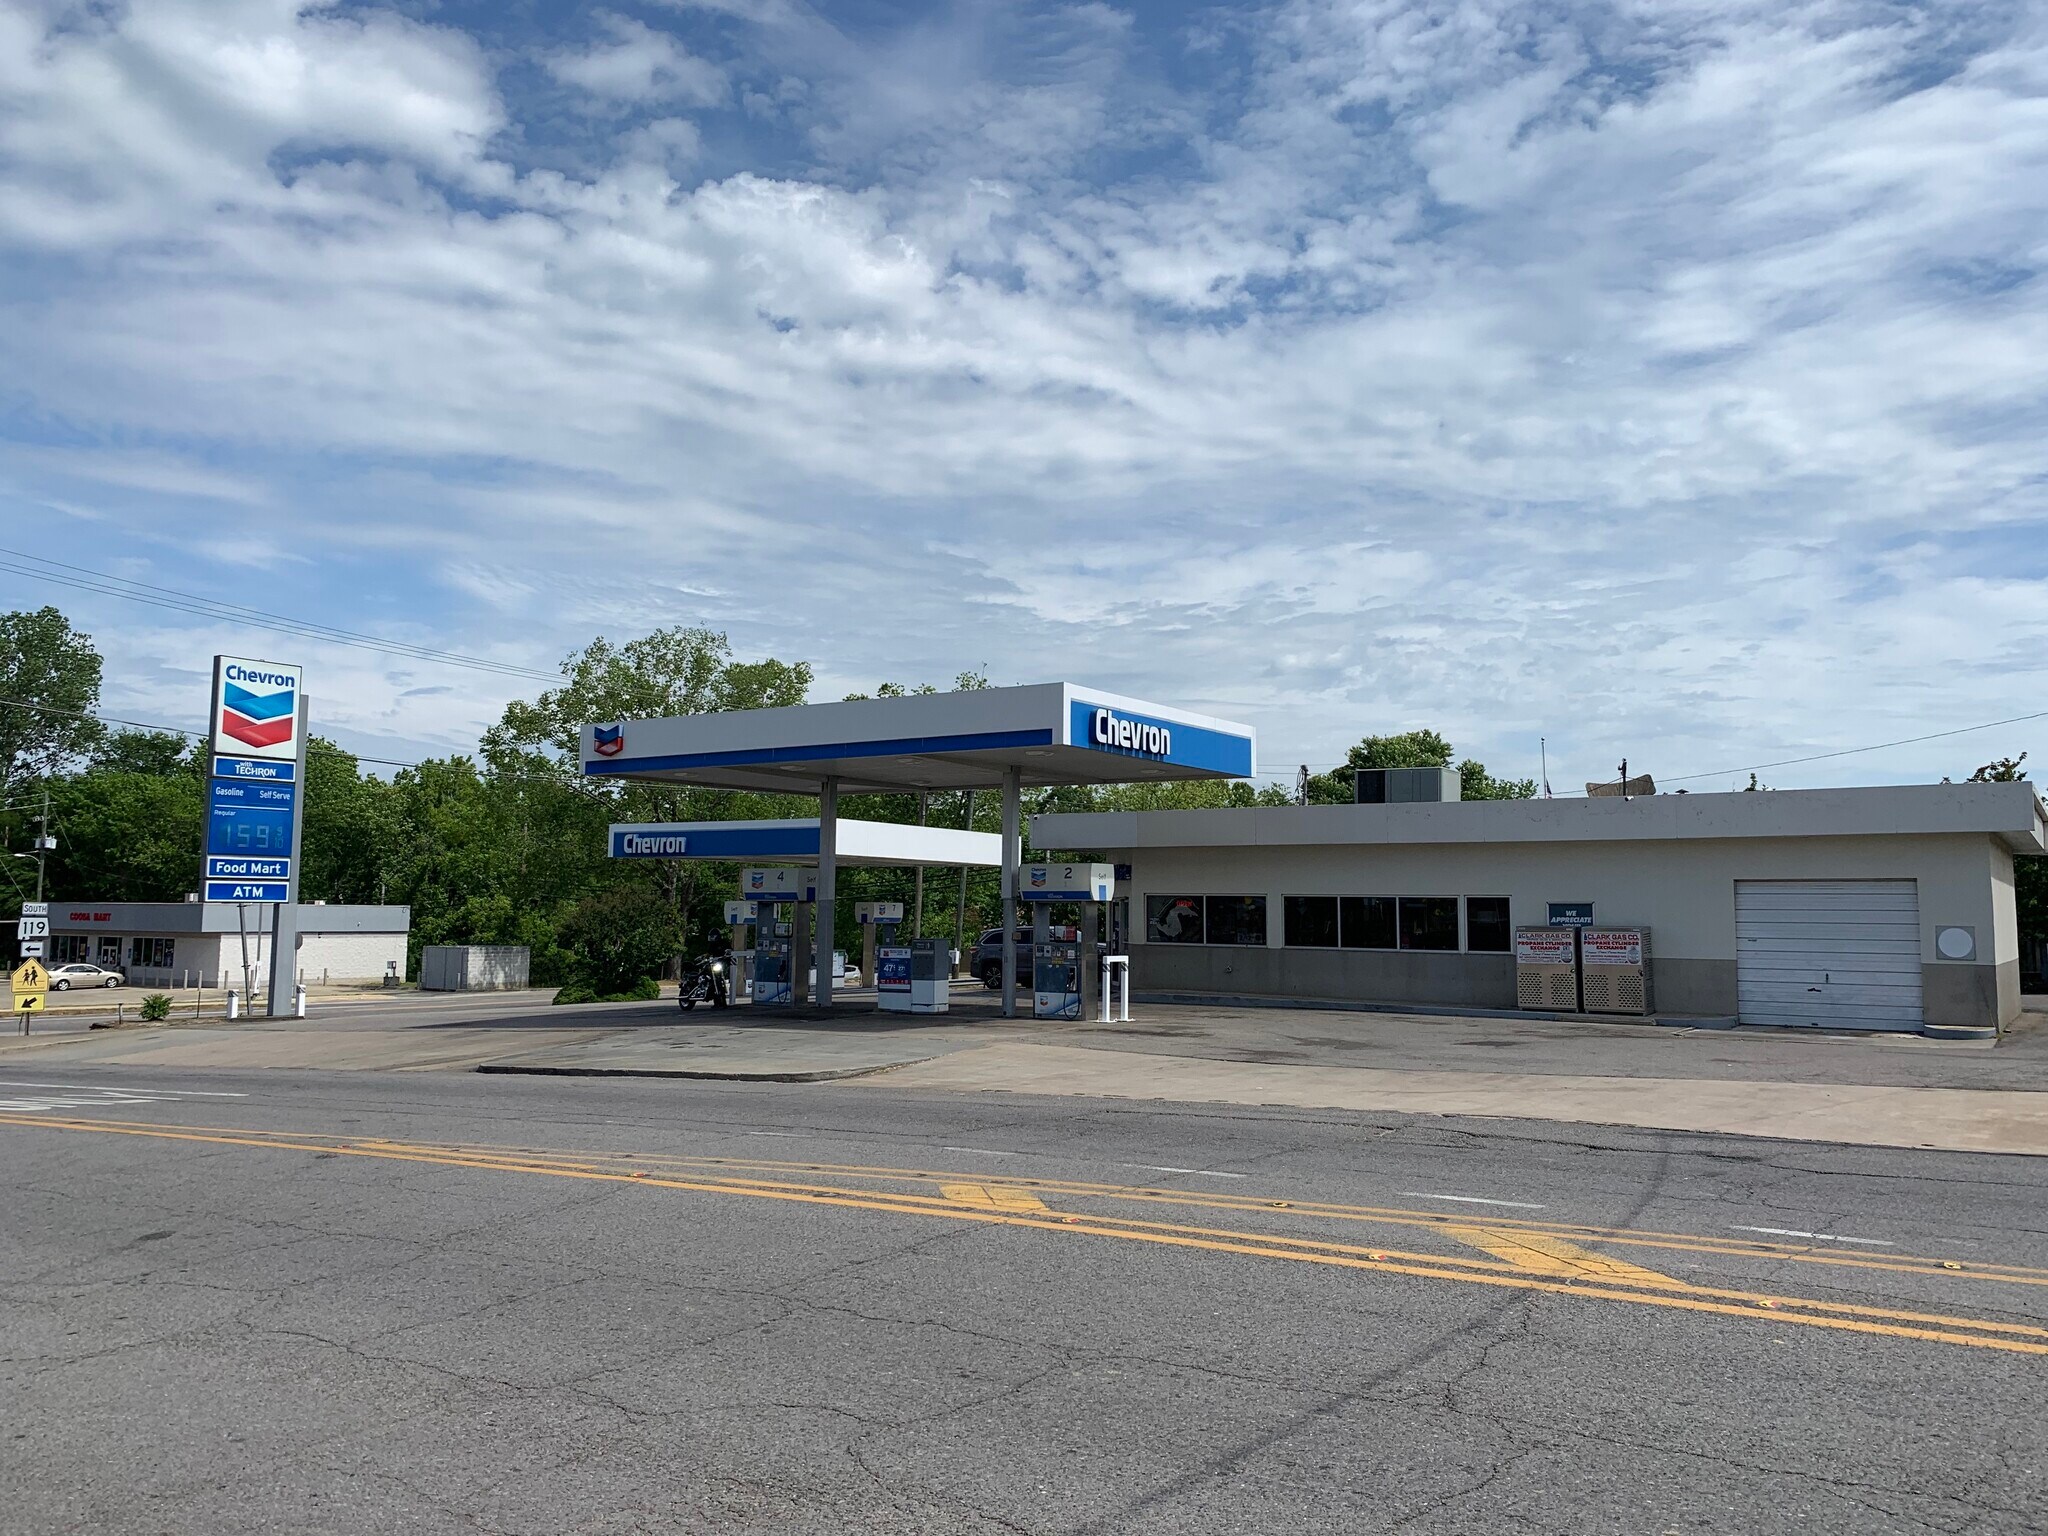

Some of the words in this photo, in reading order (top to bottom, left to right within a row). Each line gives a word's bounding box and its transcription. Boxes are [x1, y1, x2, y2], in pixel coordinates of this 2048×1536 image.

[225, 664, 295, 688] Chevron
[1095, 708, 1171, 755] Chevron
[234, 764, 277, 778] TECHRON
[215, 786, 244, 797] Gasoline
[259, 790, 272, 799] Self
[272, 791, 291, 800] Serve
[213, 809, 237, 817] Regular
[623, 833, 687, 854] Chevron
[215, 861, 247, 874] Food
[250, 861, 281, 874] Mart
[1063, 867, 1073, 879] 2
[777, 871, 785, 882] 4
[232, 886, 264, 898] ATM
[23, 904, 47, 913] SOUTH
[1550, 916, 1592, 924] APPRECIATE
[22, 921, 46, 935] 119
